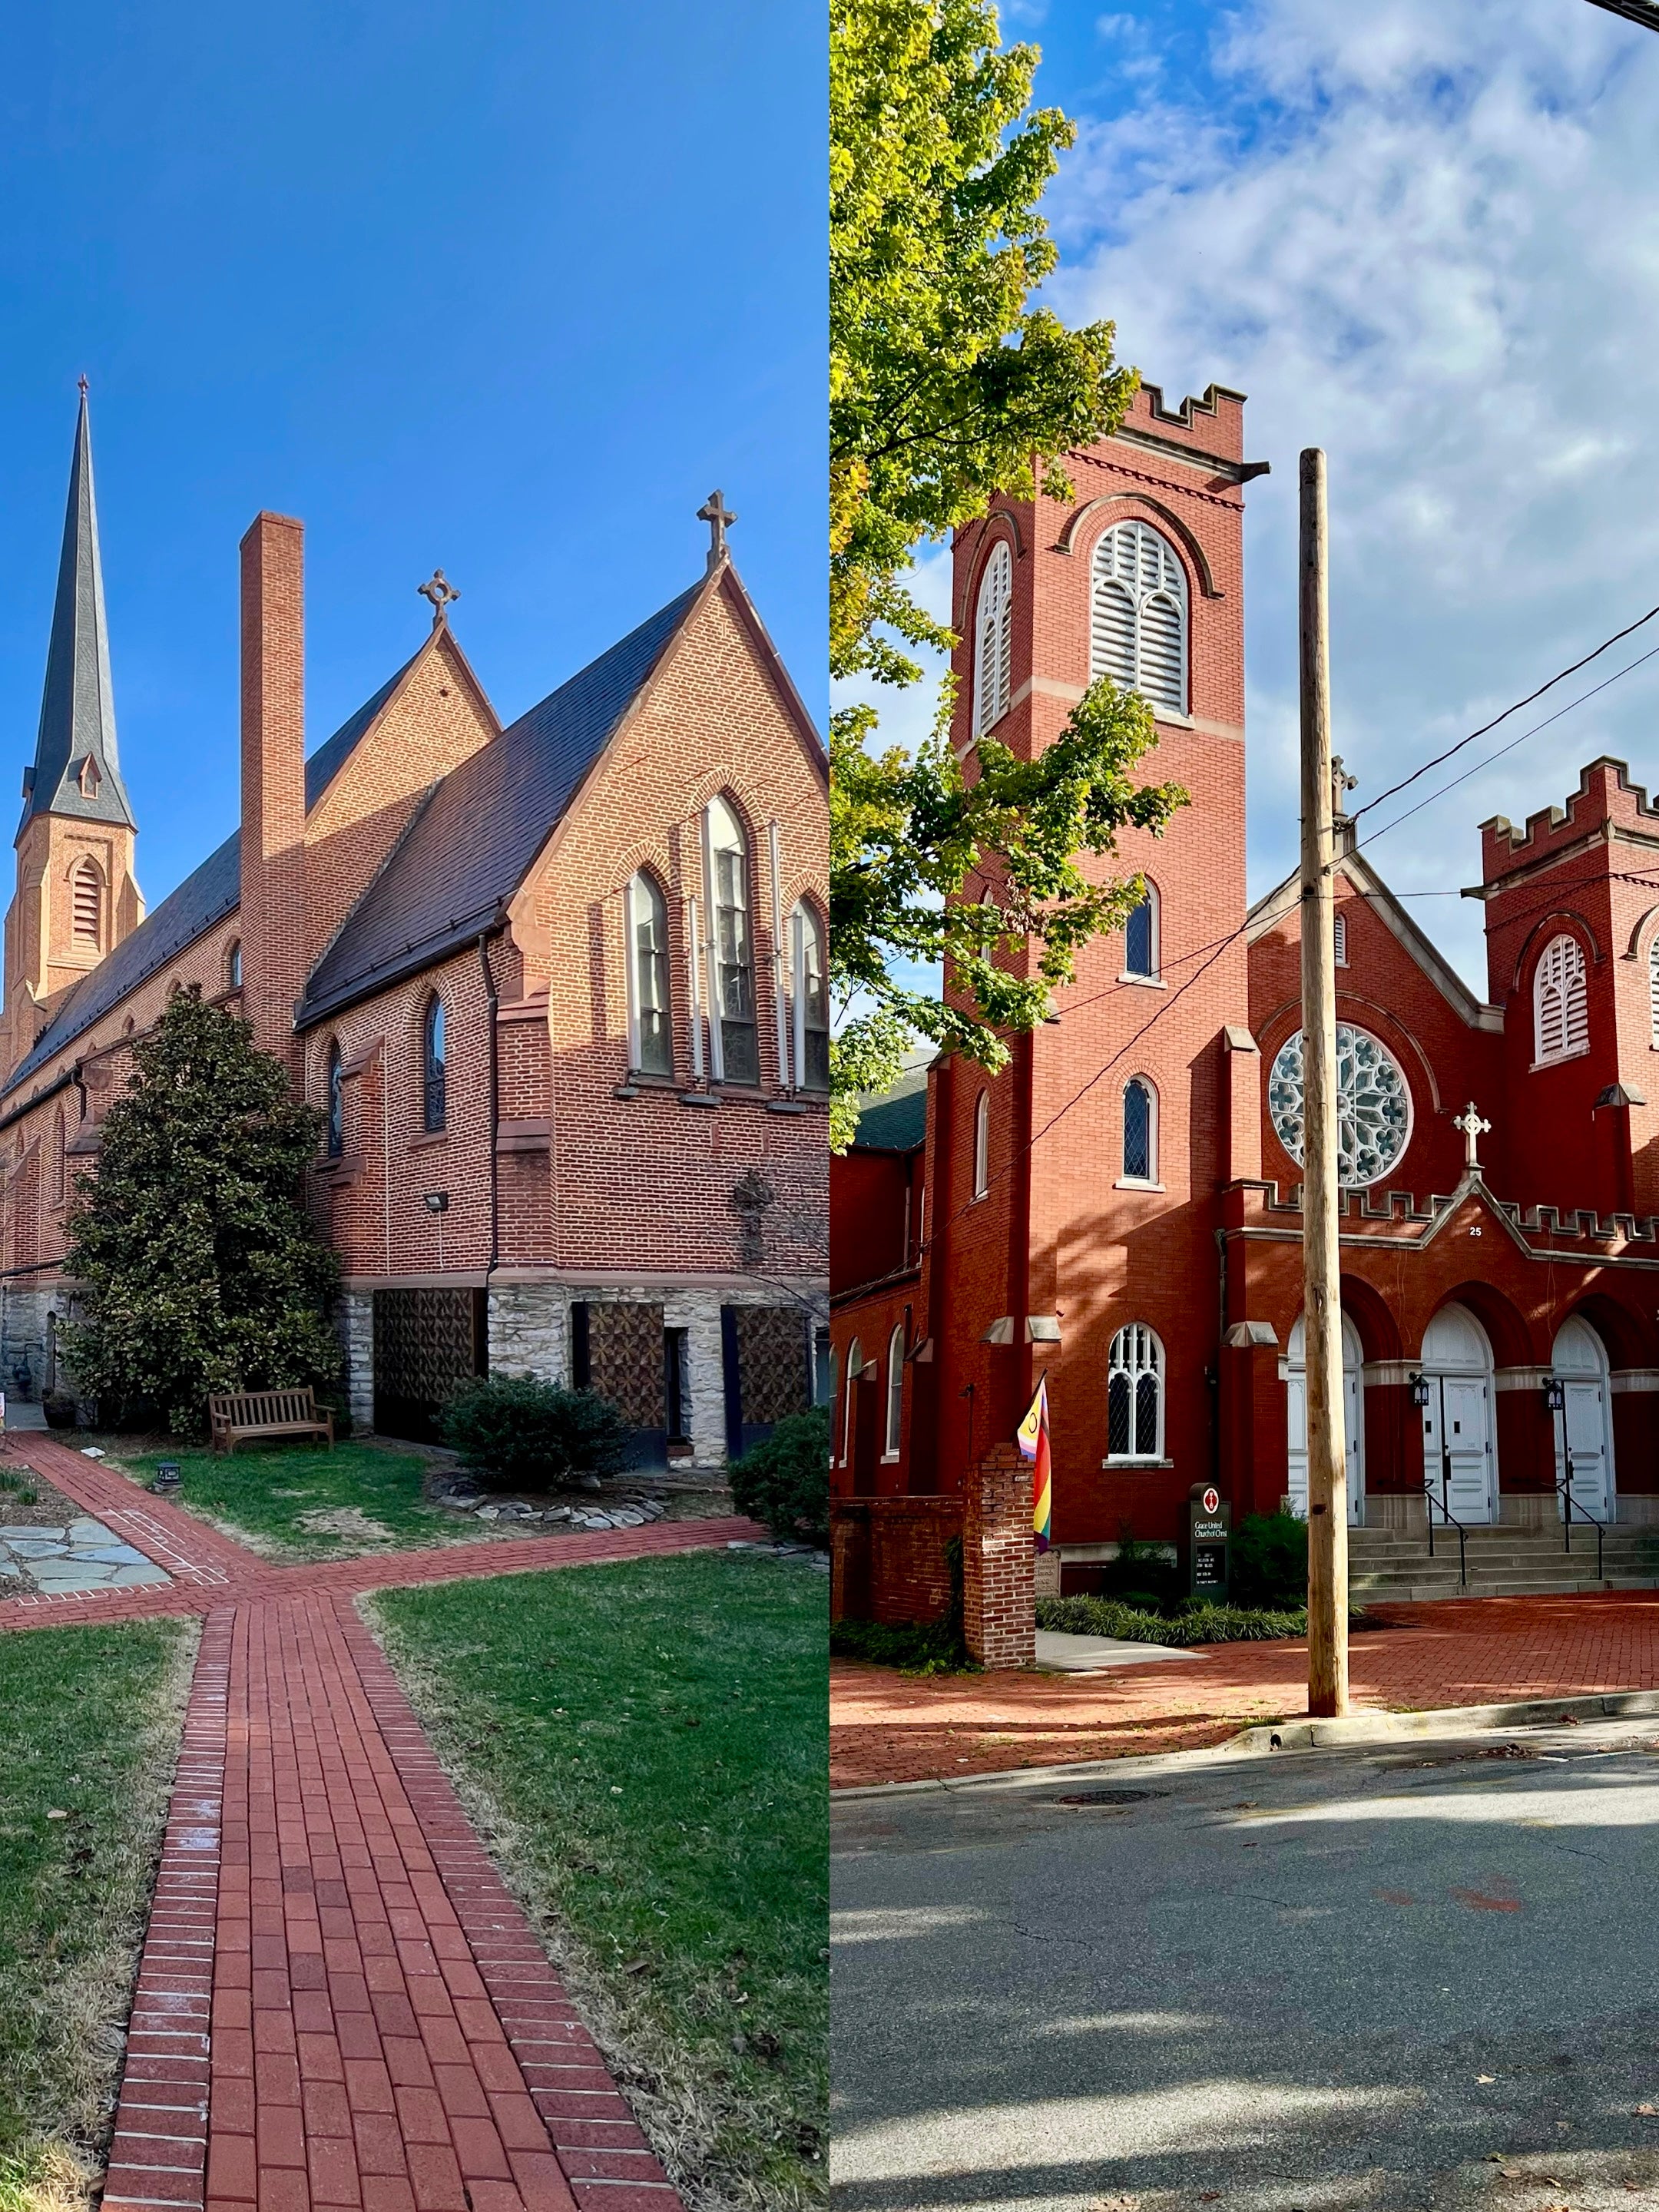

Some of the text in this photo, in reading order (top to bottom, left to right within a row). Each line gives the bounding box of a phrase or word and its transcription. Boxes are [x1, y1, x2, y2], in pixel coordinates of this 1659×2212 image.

[1469, 1227, 1482, 1237] 25
[1194, 1521, 1223, 1529] Grace United
[1194, 1529, 1210, 1538] Church
[1215, 1529, 1227, 1538] Christ
